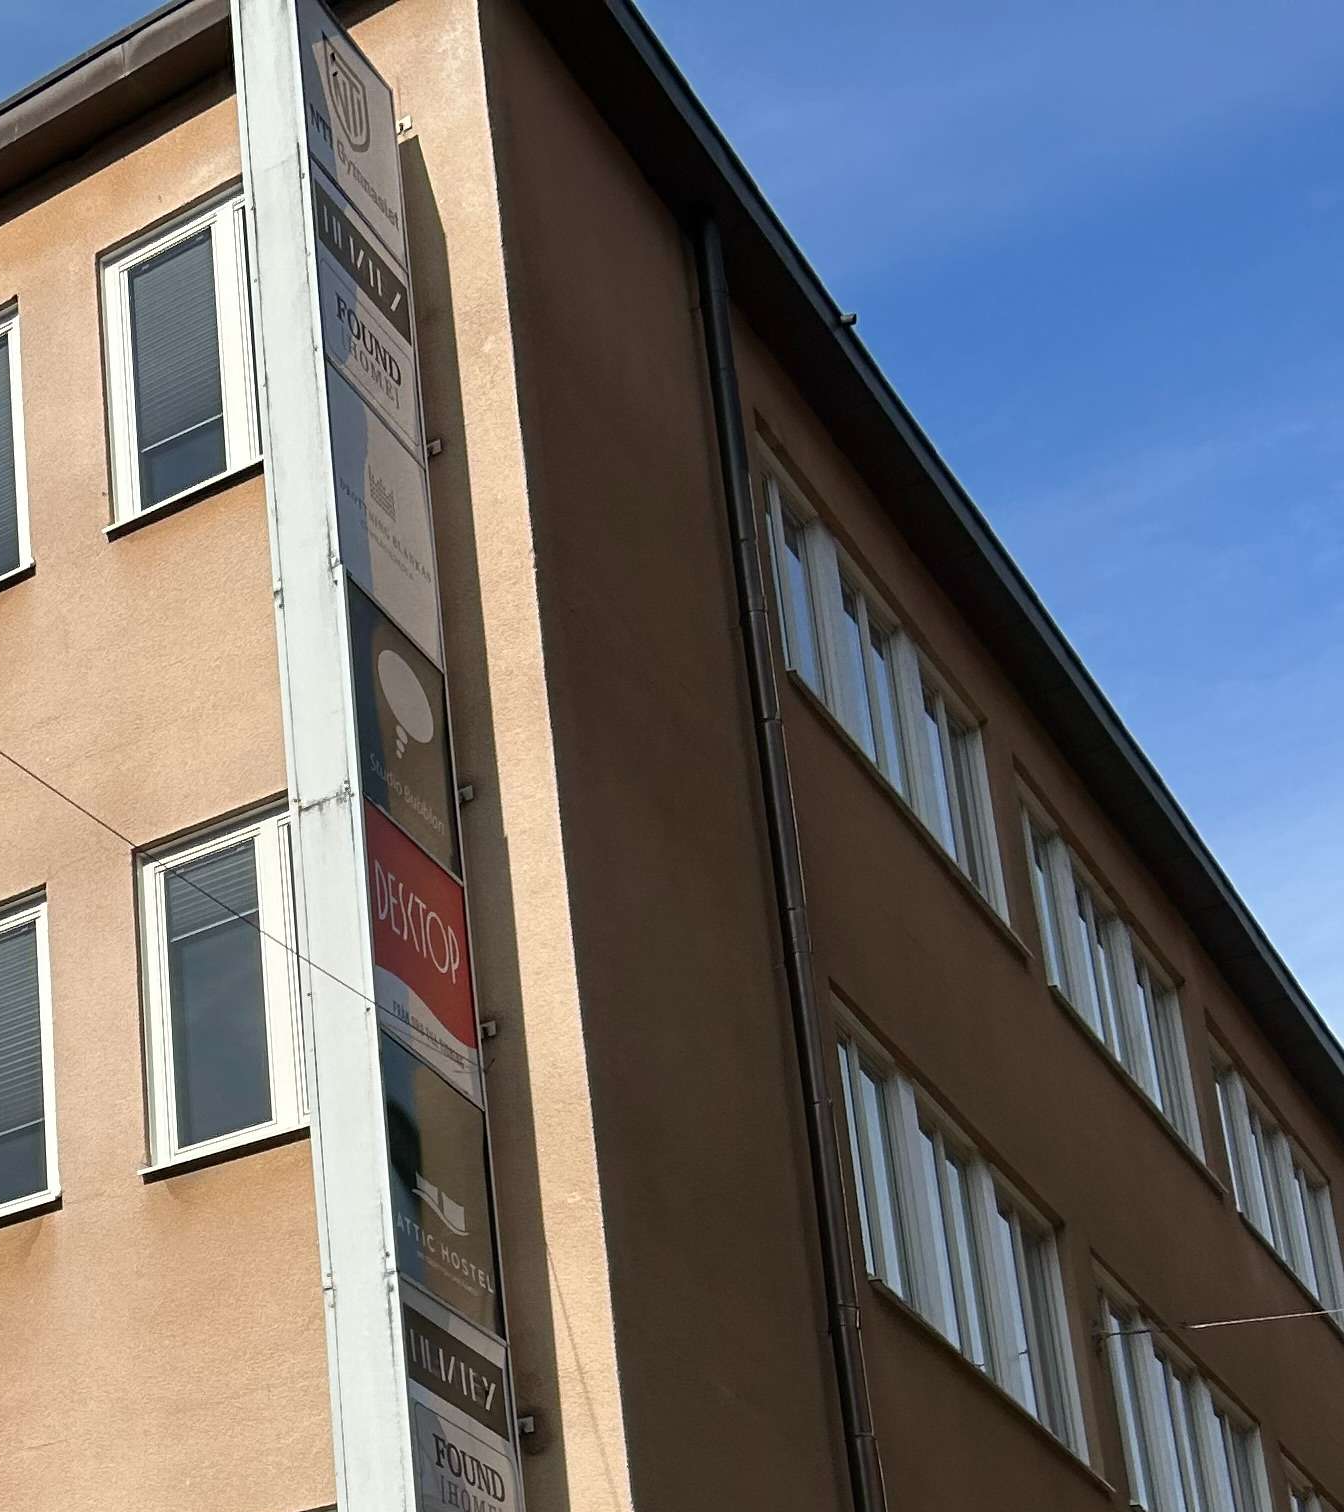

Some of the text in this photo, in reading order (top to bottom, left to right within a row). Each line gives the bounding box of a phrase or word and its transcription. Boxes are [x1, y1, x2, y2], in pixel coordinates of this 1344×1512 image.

[336, 138, 400, 232] Gymnasiet
[335, 292, 403, 386] FOUND
[374, 858, 460, 984] DESKTOP
[395, 1211, 435, 1253] ATTIC
[440, 1243, 495, 1295] HOSTEL
[432, 1432, 506, 1503] FOUND
